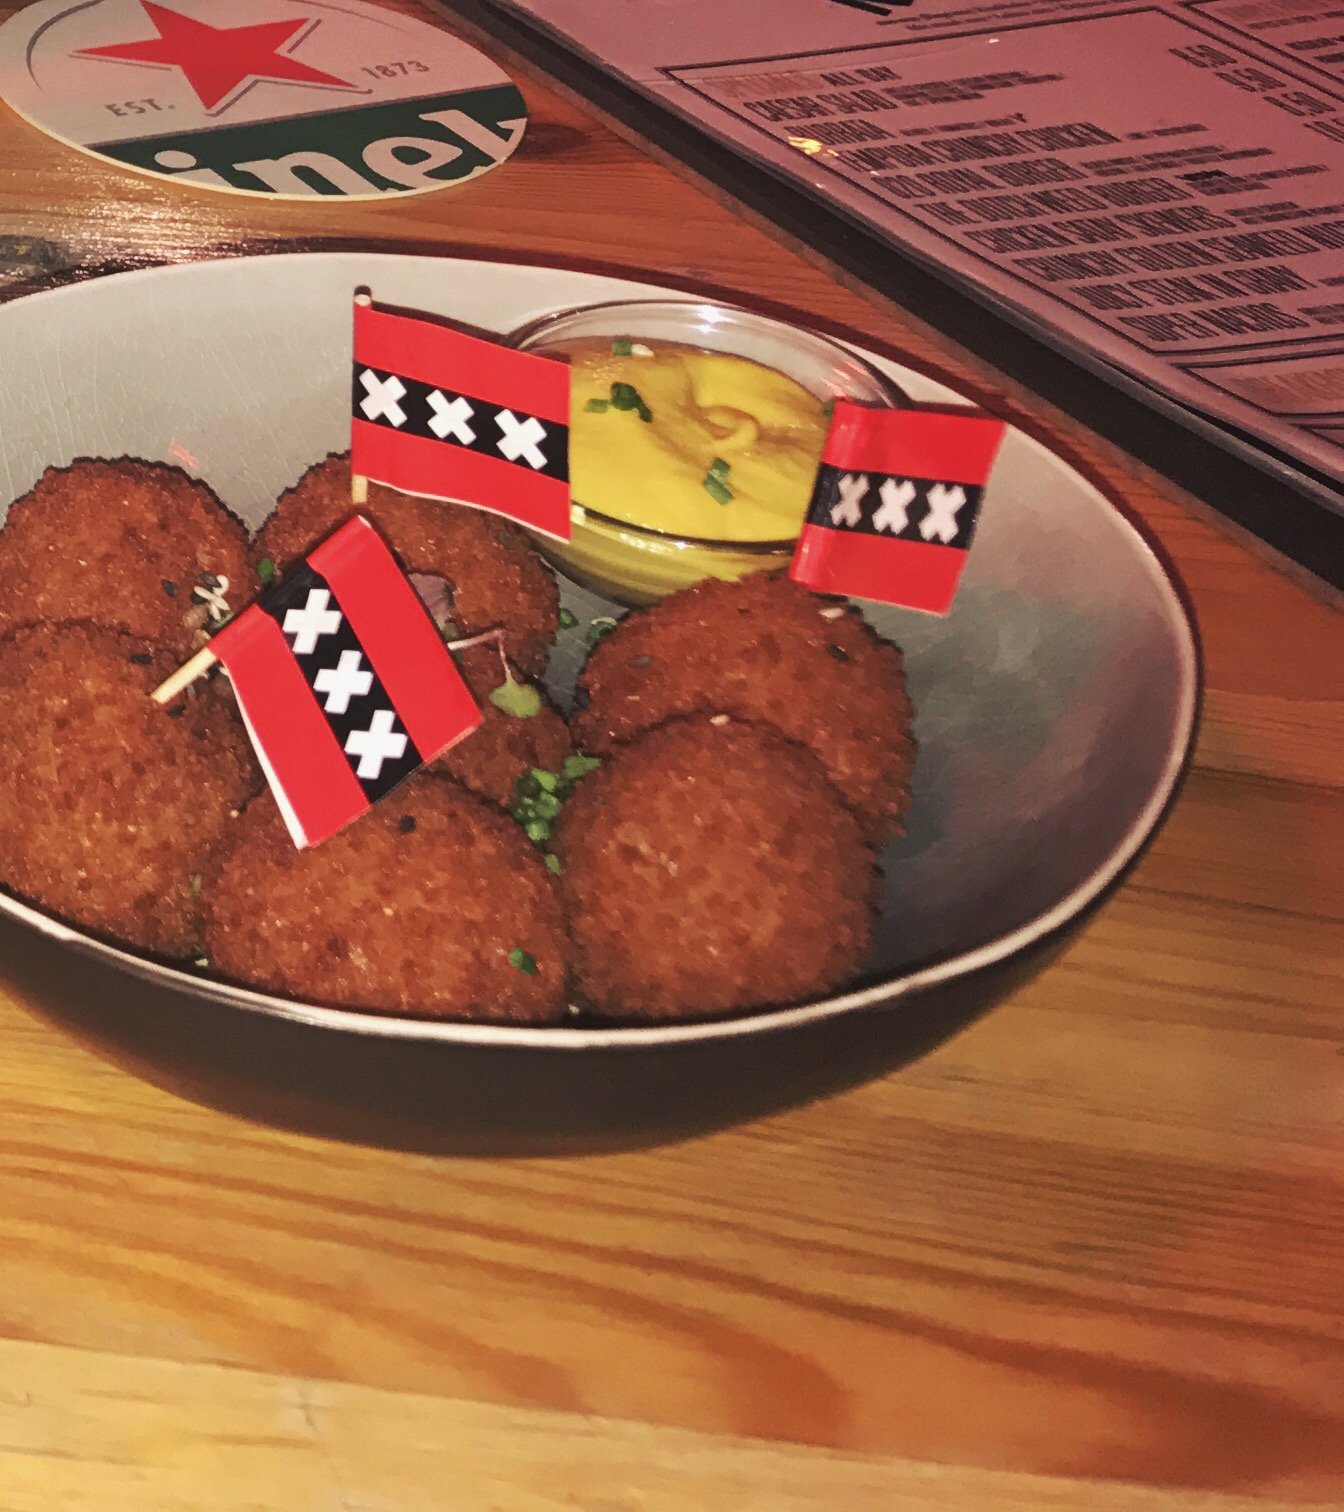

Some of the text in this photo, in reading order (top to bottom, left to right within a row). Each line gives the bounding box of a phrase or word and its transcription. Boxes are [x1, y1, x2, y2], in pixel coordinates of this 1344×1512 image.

[359, 59, 430, 81] 1873
[104, 97, 177, 118] EST.
[816, 89, 897, 113] SALAD
[1015, 122, 1120, 151] CHICKEN
[981, 158, 1087, 186] BURGER
[913, 201, 981, 225] THE
[956, 194, 1049, 221] DUTCH
[1023, 187, 1107, 213] WEED
[1085, 177, 1193, 207] BURGER
[963, 224, 1076, 253] CHICKEN
[1052, 216, 1136, 243] SATAY
[1114, 205, 1235, 236] SKEWERS
[1012, 250, 1135, 281] CRUNCHY
[1114, 241, 1224, 271] GOLDEN
[1198, 229, 1319, 261] SEAWEED
[1069, 265, 1316, 310] JUICY STEAK IN GRAVY
[1117, 312, 1218, 341] SUPER
[1191, 302, 1309, 334] NACHOS
